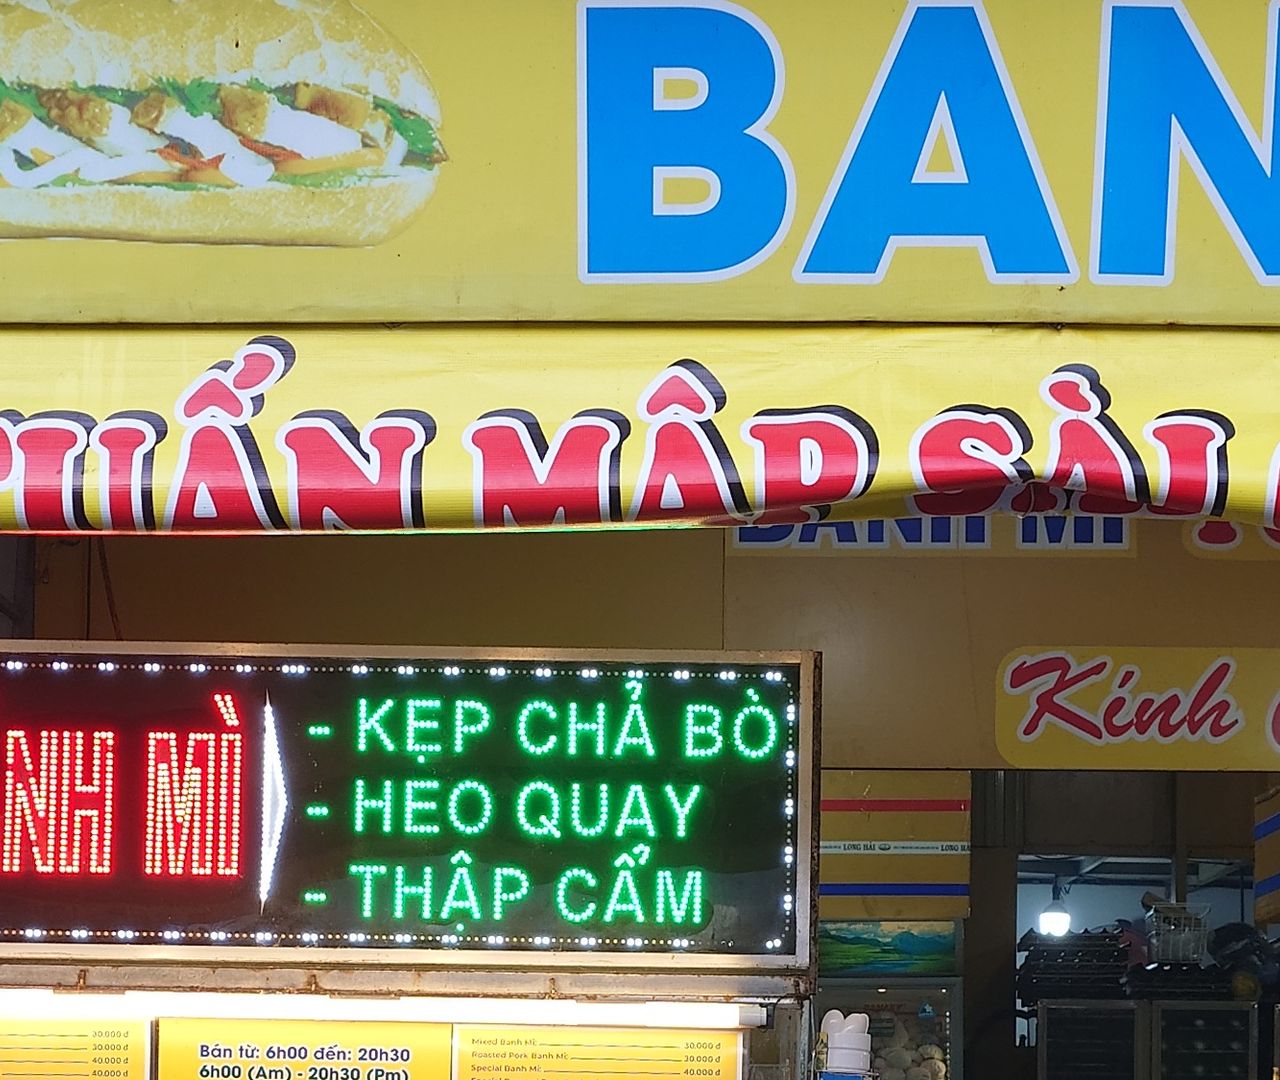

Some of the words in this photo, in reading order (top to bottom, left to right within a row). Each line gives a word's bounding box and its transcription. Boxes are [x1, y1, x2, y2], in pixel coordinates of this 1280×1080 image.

[912, 366, 1228, 517] SÀI
[356, 697, 492, 764] KẸP
[517, 680, 656, 758] CHẢ
[684, 686, 778, 758] BÒ
[1008, 655, 1240, 741] Kính
[143, 692, 243, 876] MÌ
[353, 778, 493, 834] HEO
[516, 781, 702, 839] QUAY
[348, 849, 529, 932] THẬP
[555, 843, 703, 924] CẨM
[199, 1065, 241, 1079] 6h00
[200, 1044, 232, 1059] Bán
[239, 1045, 260, 1060] từ:
[266, 1046, 308, 1060] 6h00
[313, 1044, 352, 1061] đến:
[358, 1047, 410, 1062] 20h30
